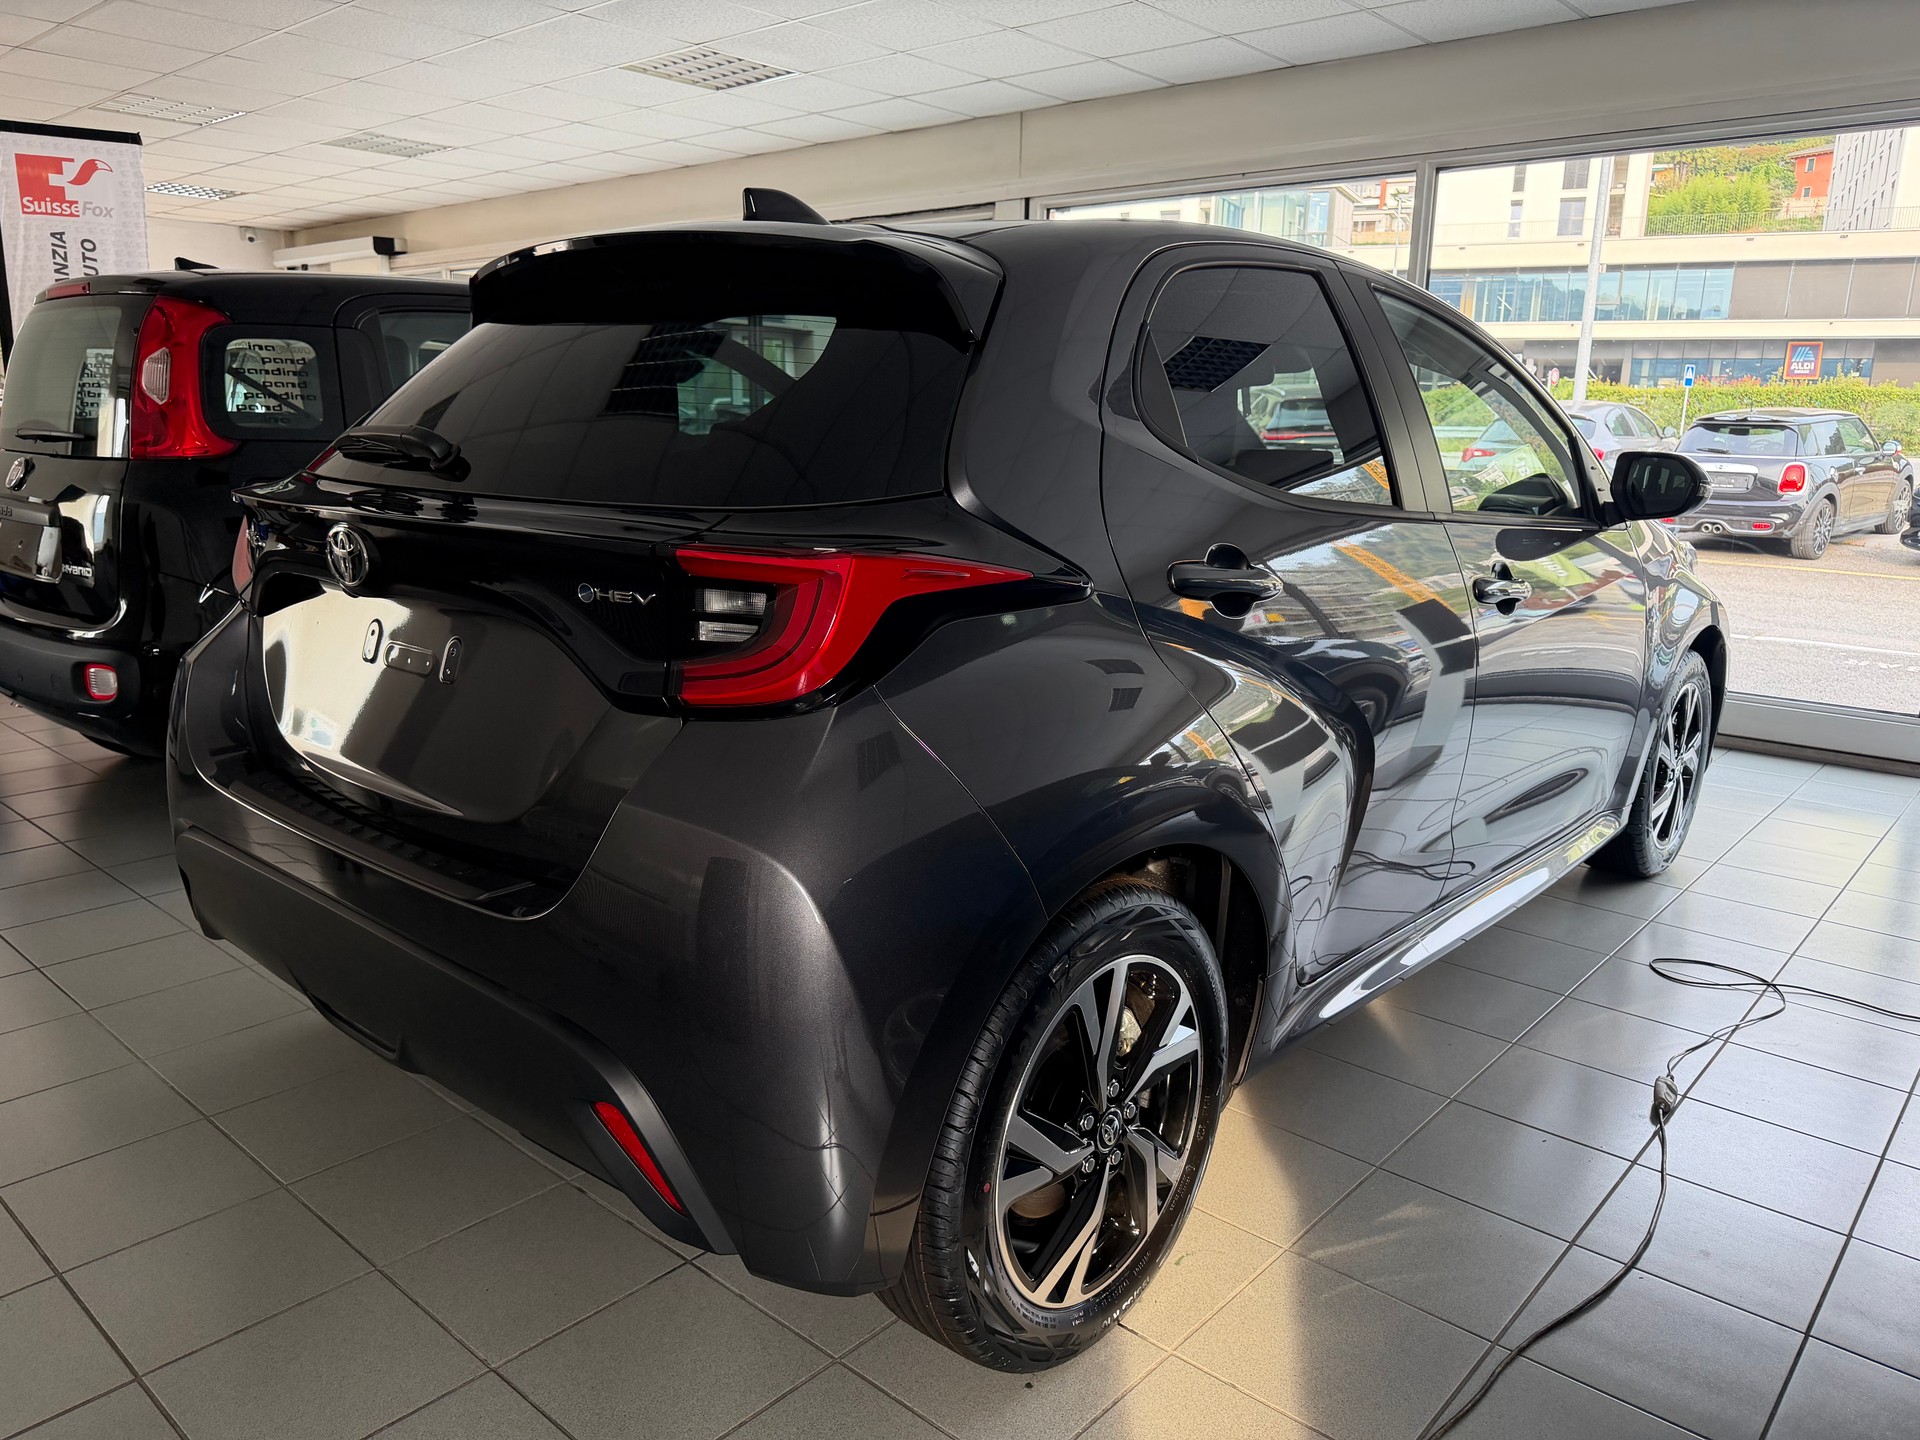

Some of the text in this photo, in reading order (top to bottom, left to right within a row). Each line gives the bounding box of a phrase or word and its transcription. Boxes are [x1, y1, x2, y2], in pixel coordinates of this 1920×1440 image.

[22, 196, 114, 218] SuisseFox
[1790, 362, 1815, 370] ALDI
[594, 587, 656, 605] HEV
